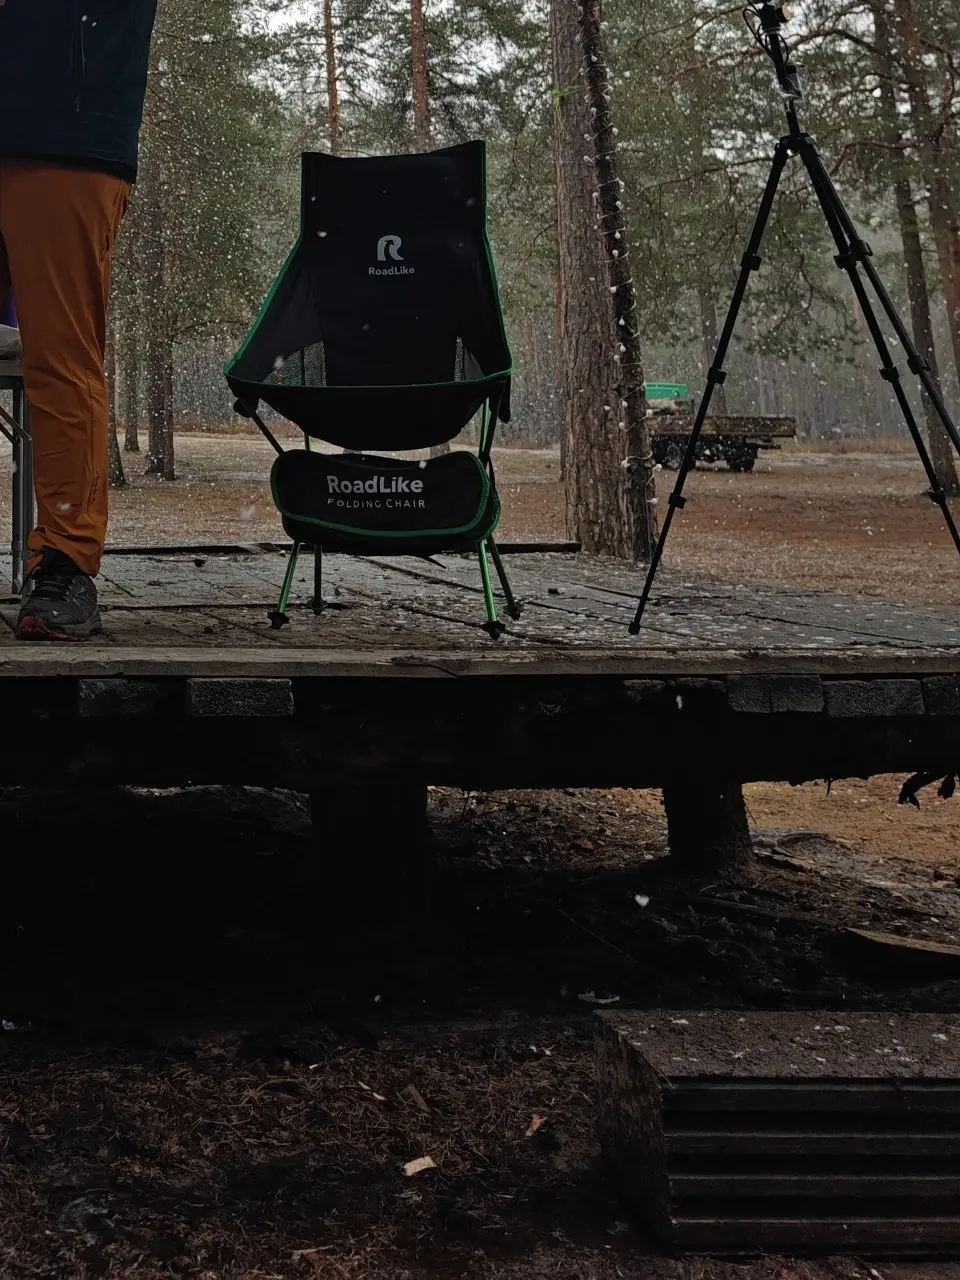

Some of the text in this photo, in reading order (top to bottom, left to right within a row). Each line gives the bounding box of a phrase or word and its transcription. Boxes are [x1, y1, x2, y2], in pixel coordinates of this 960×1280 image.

[368, 265, 415, 276] RoadLike
[326, 474, 424, 494] RoadLike
[327, 497, 426, 509] FOLDING CHAIR
